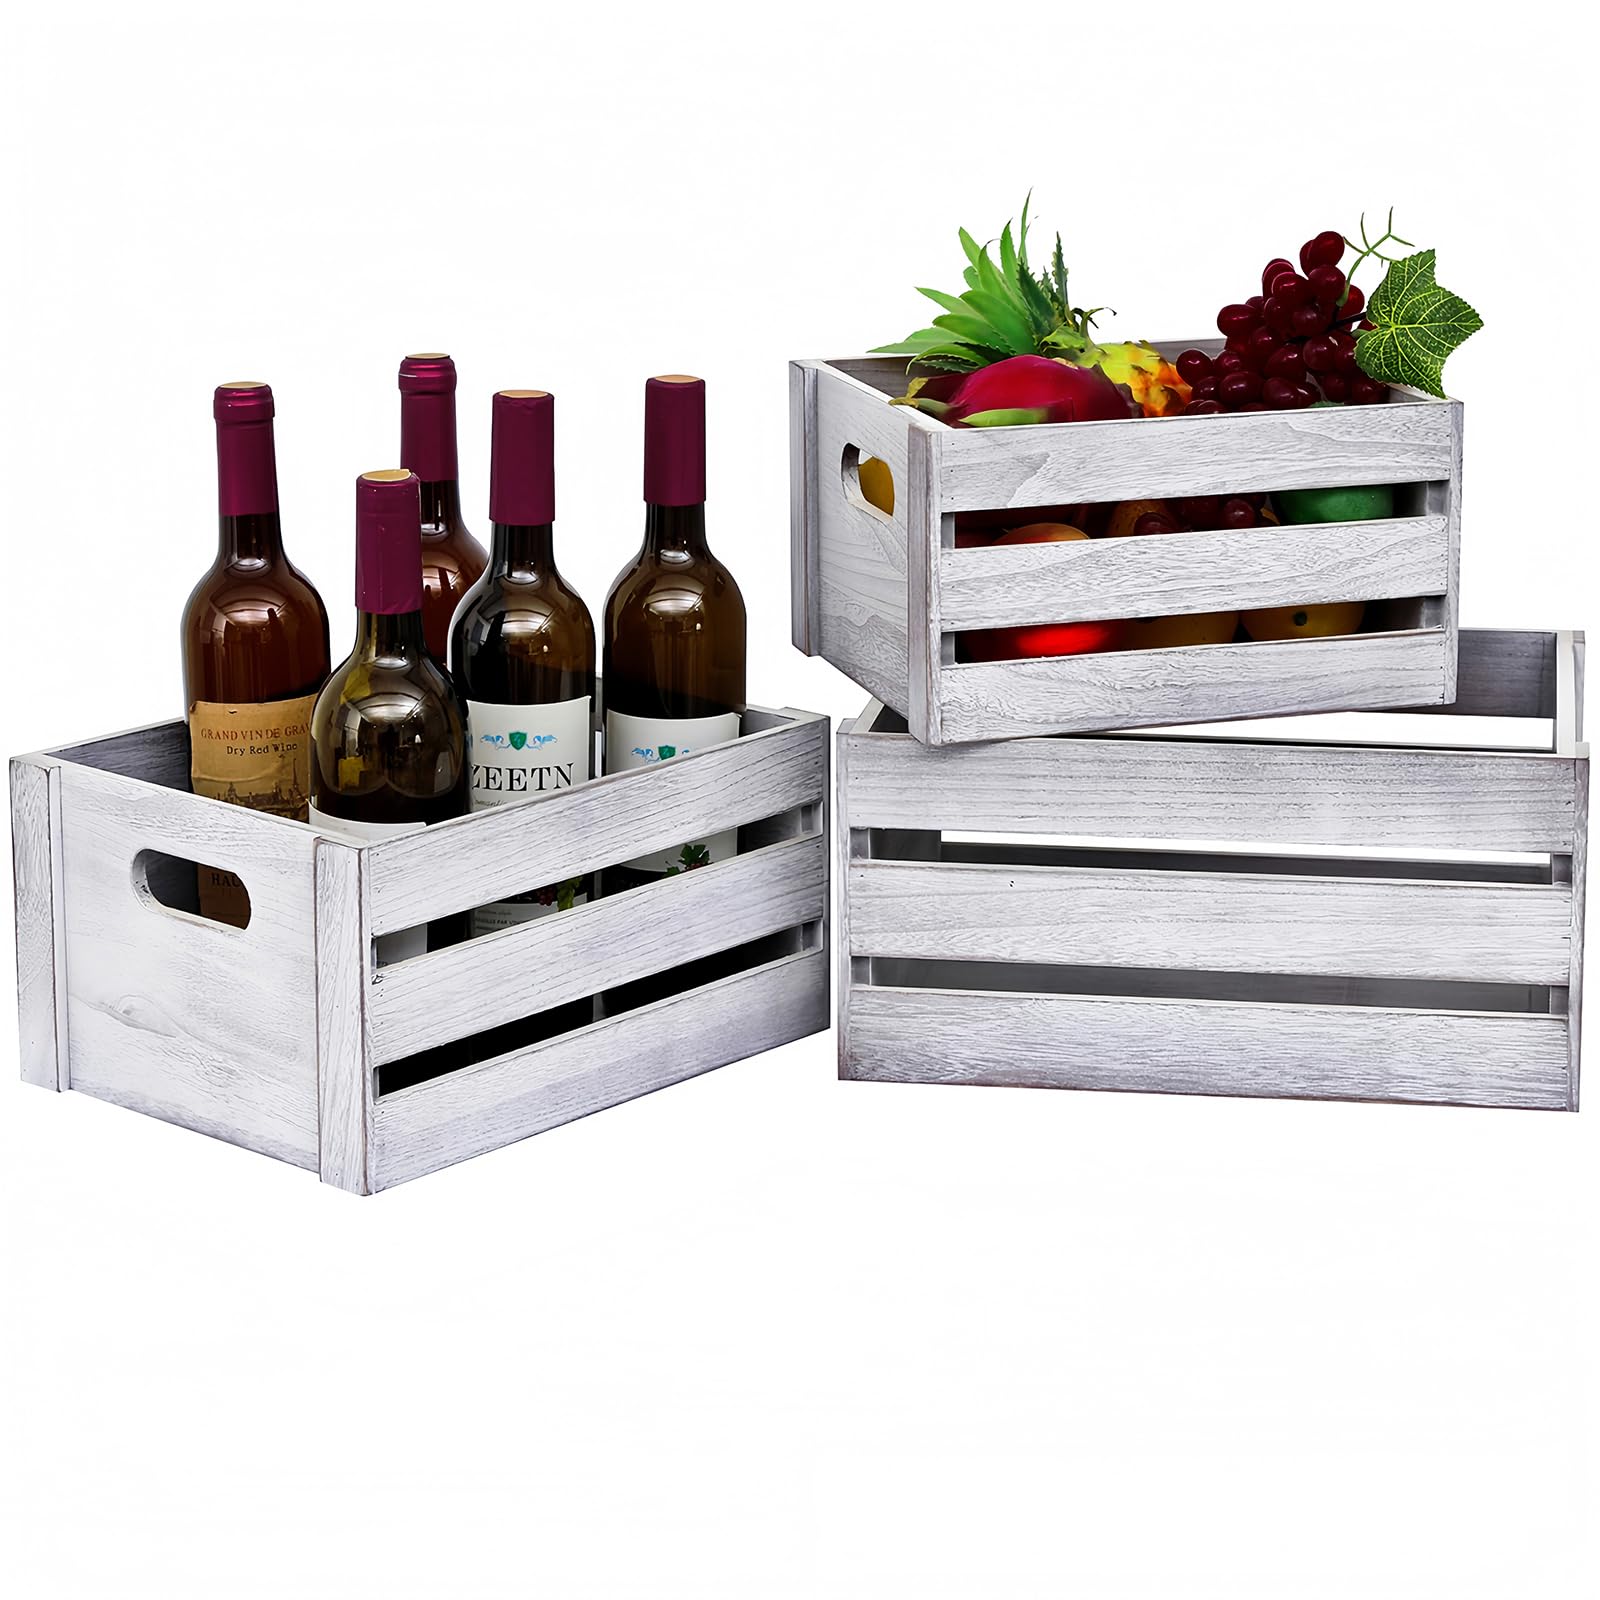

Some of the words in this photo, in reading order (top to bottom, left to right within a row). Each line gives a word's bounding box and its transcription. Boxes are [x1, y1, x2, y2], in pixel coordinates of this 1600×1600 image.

[201, 728, 238, 741] GRAND
[240, 730, 263, 740] VIN
[265, 728, 281, 739] DE
[226, 745, 246, 757] Dry
[249, 745, 269, 755] Red
[271, 743, 298, 753] Wine
[471, 762, 575, 792] ZEETN
